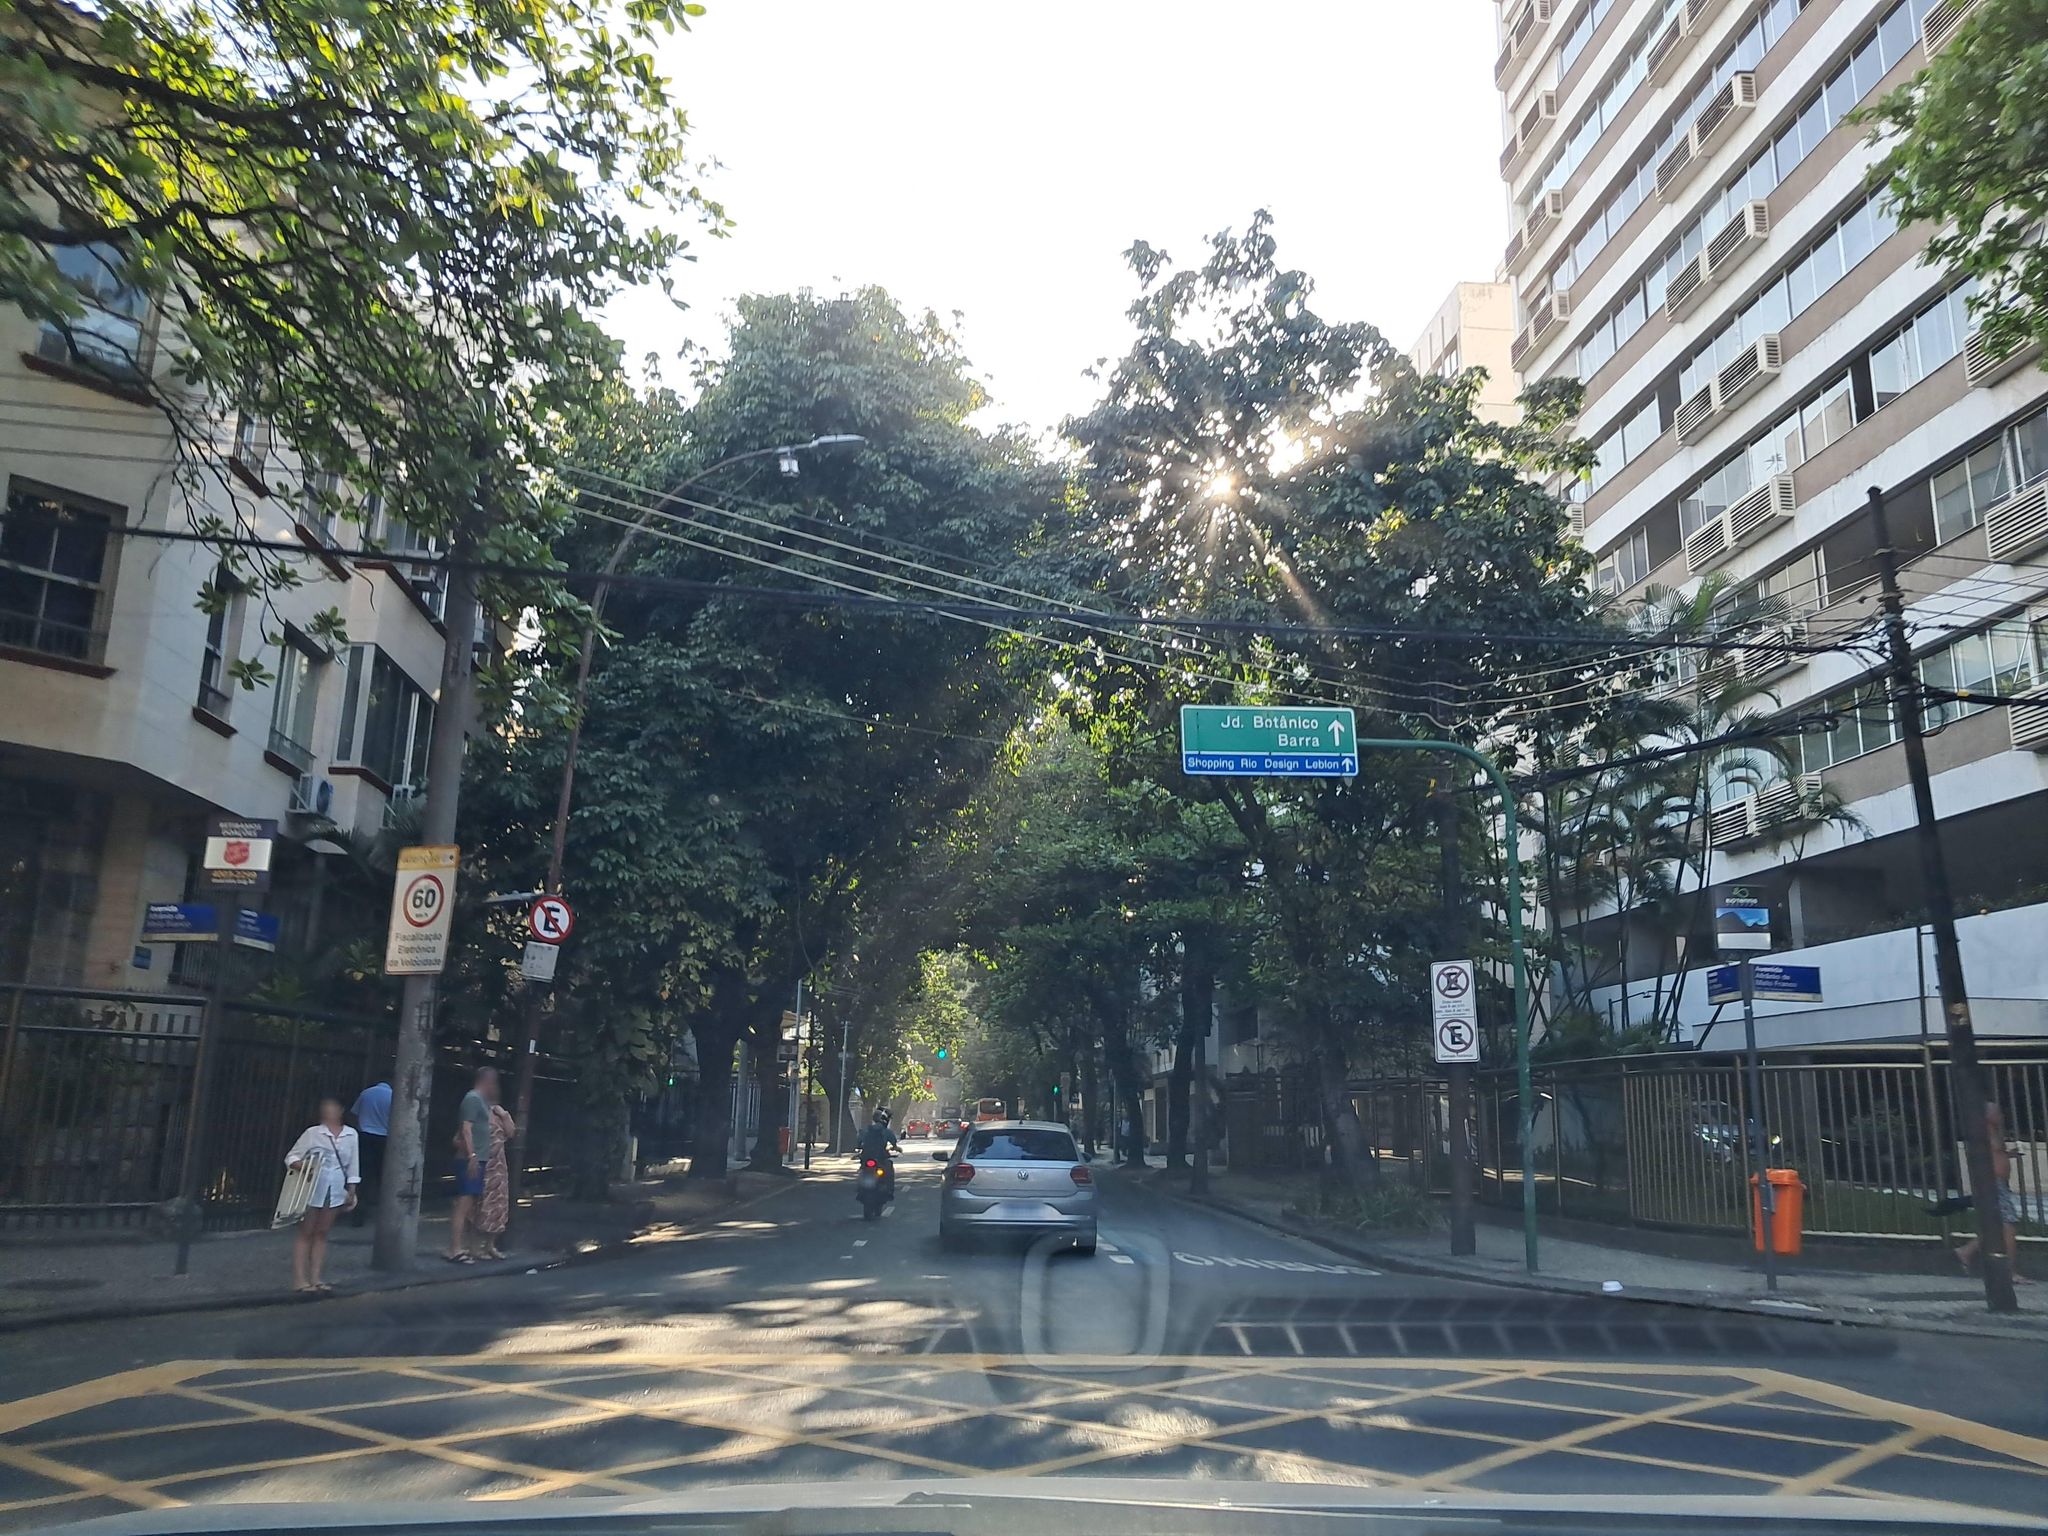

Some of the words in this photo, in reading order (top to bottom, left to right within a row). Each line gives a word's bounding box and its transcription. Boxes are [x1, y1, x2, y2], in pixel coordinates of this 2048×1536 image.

[1221, 715, 1244, 729] Jd.
[1253, 715, 1319, 730] Botânico
[1278, 734, 1320, 748] Barra
[1187, 757, 1235, 770] Shopping
[1240, 757, 1258, 769] Rio
[1264, 758, 1300, 771] Design
[1305, 758, 1339, 770] Leblon
[412, 889, 436, 908] 60
[543, 906, 560, 932] E
[395, 932, 443, 942] Fiscalização
[397, 944, 437, 954] Eletrônica
[388, 959, 400, 967] de
[401, 958, 442, 967] Velocidade
